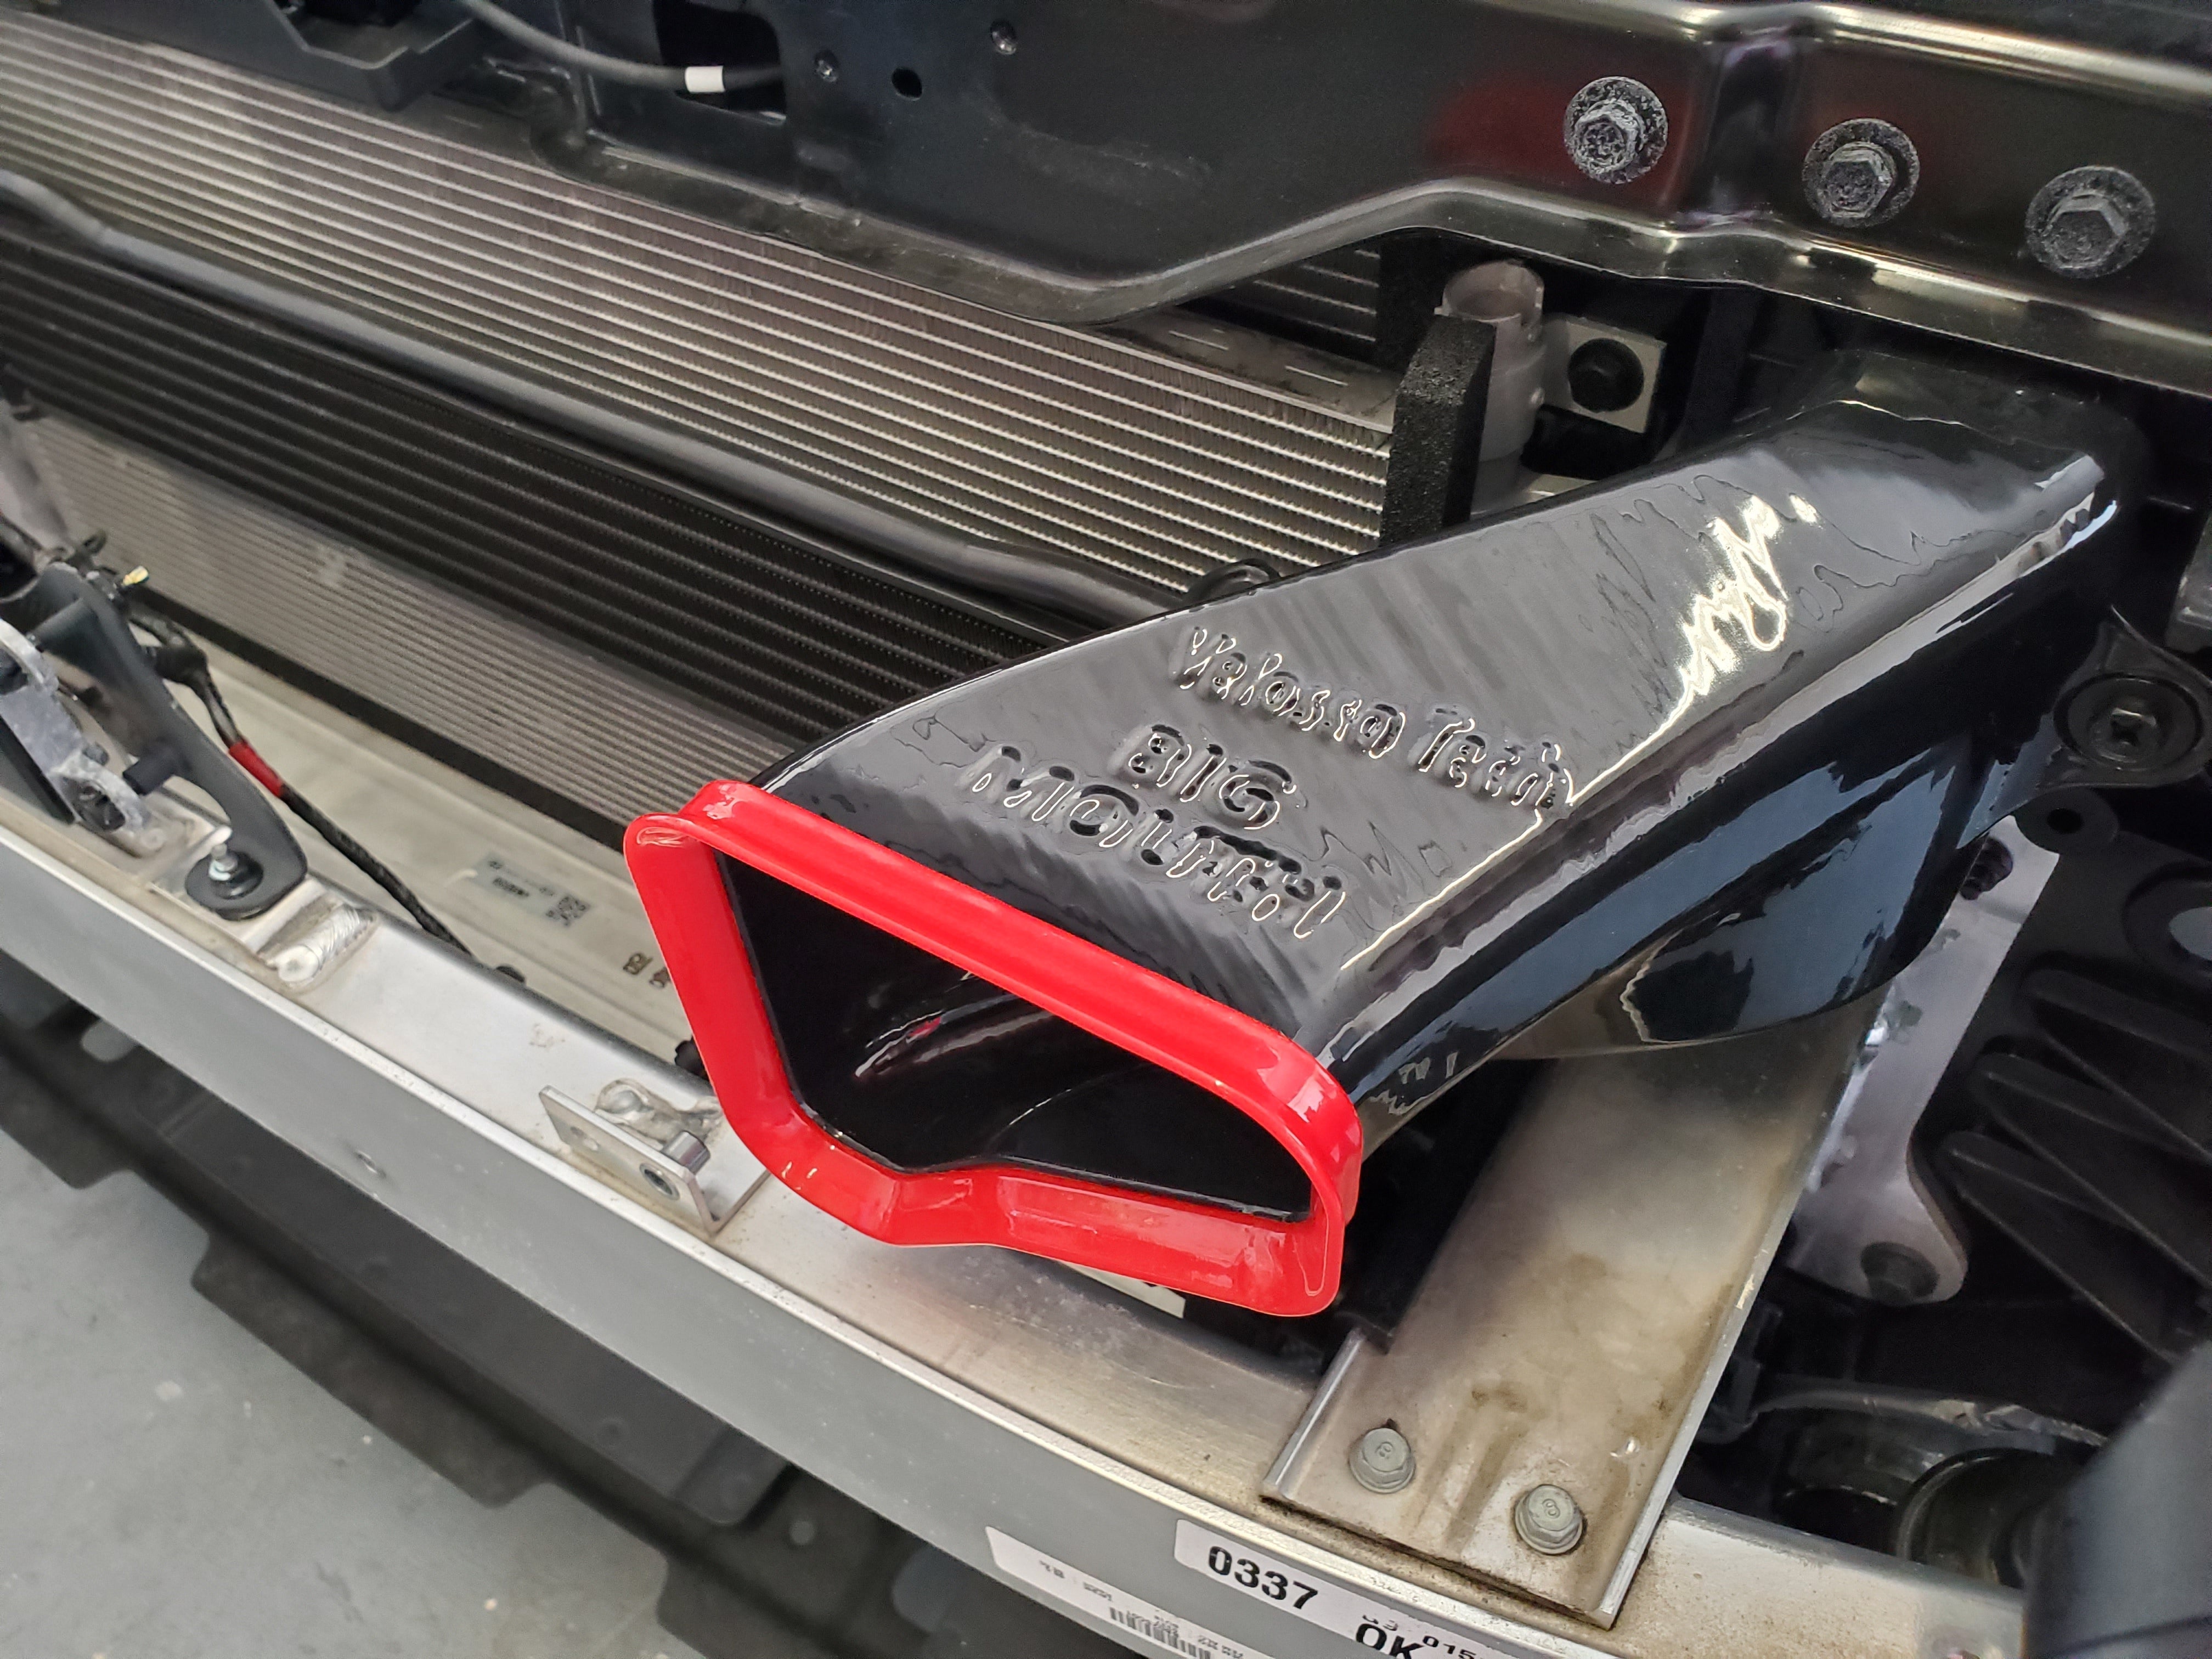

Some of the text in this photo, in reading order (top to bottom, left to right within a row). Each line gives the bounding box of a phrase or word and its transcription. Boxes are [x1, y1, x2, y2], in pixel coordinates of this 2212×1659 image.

[1116, 723, 1308, 831] BIG
[1410, 704, 1570, 812] Tech
[956, 742, 1346, 940] MOUTH
[1209, 1546, 1318, 1610] 0337
[1356, 1623, 1425, 1659] OK
